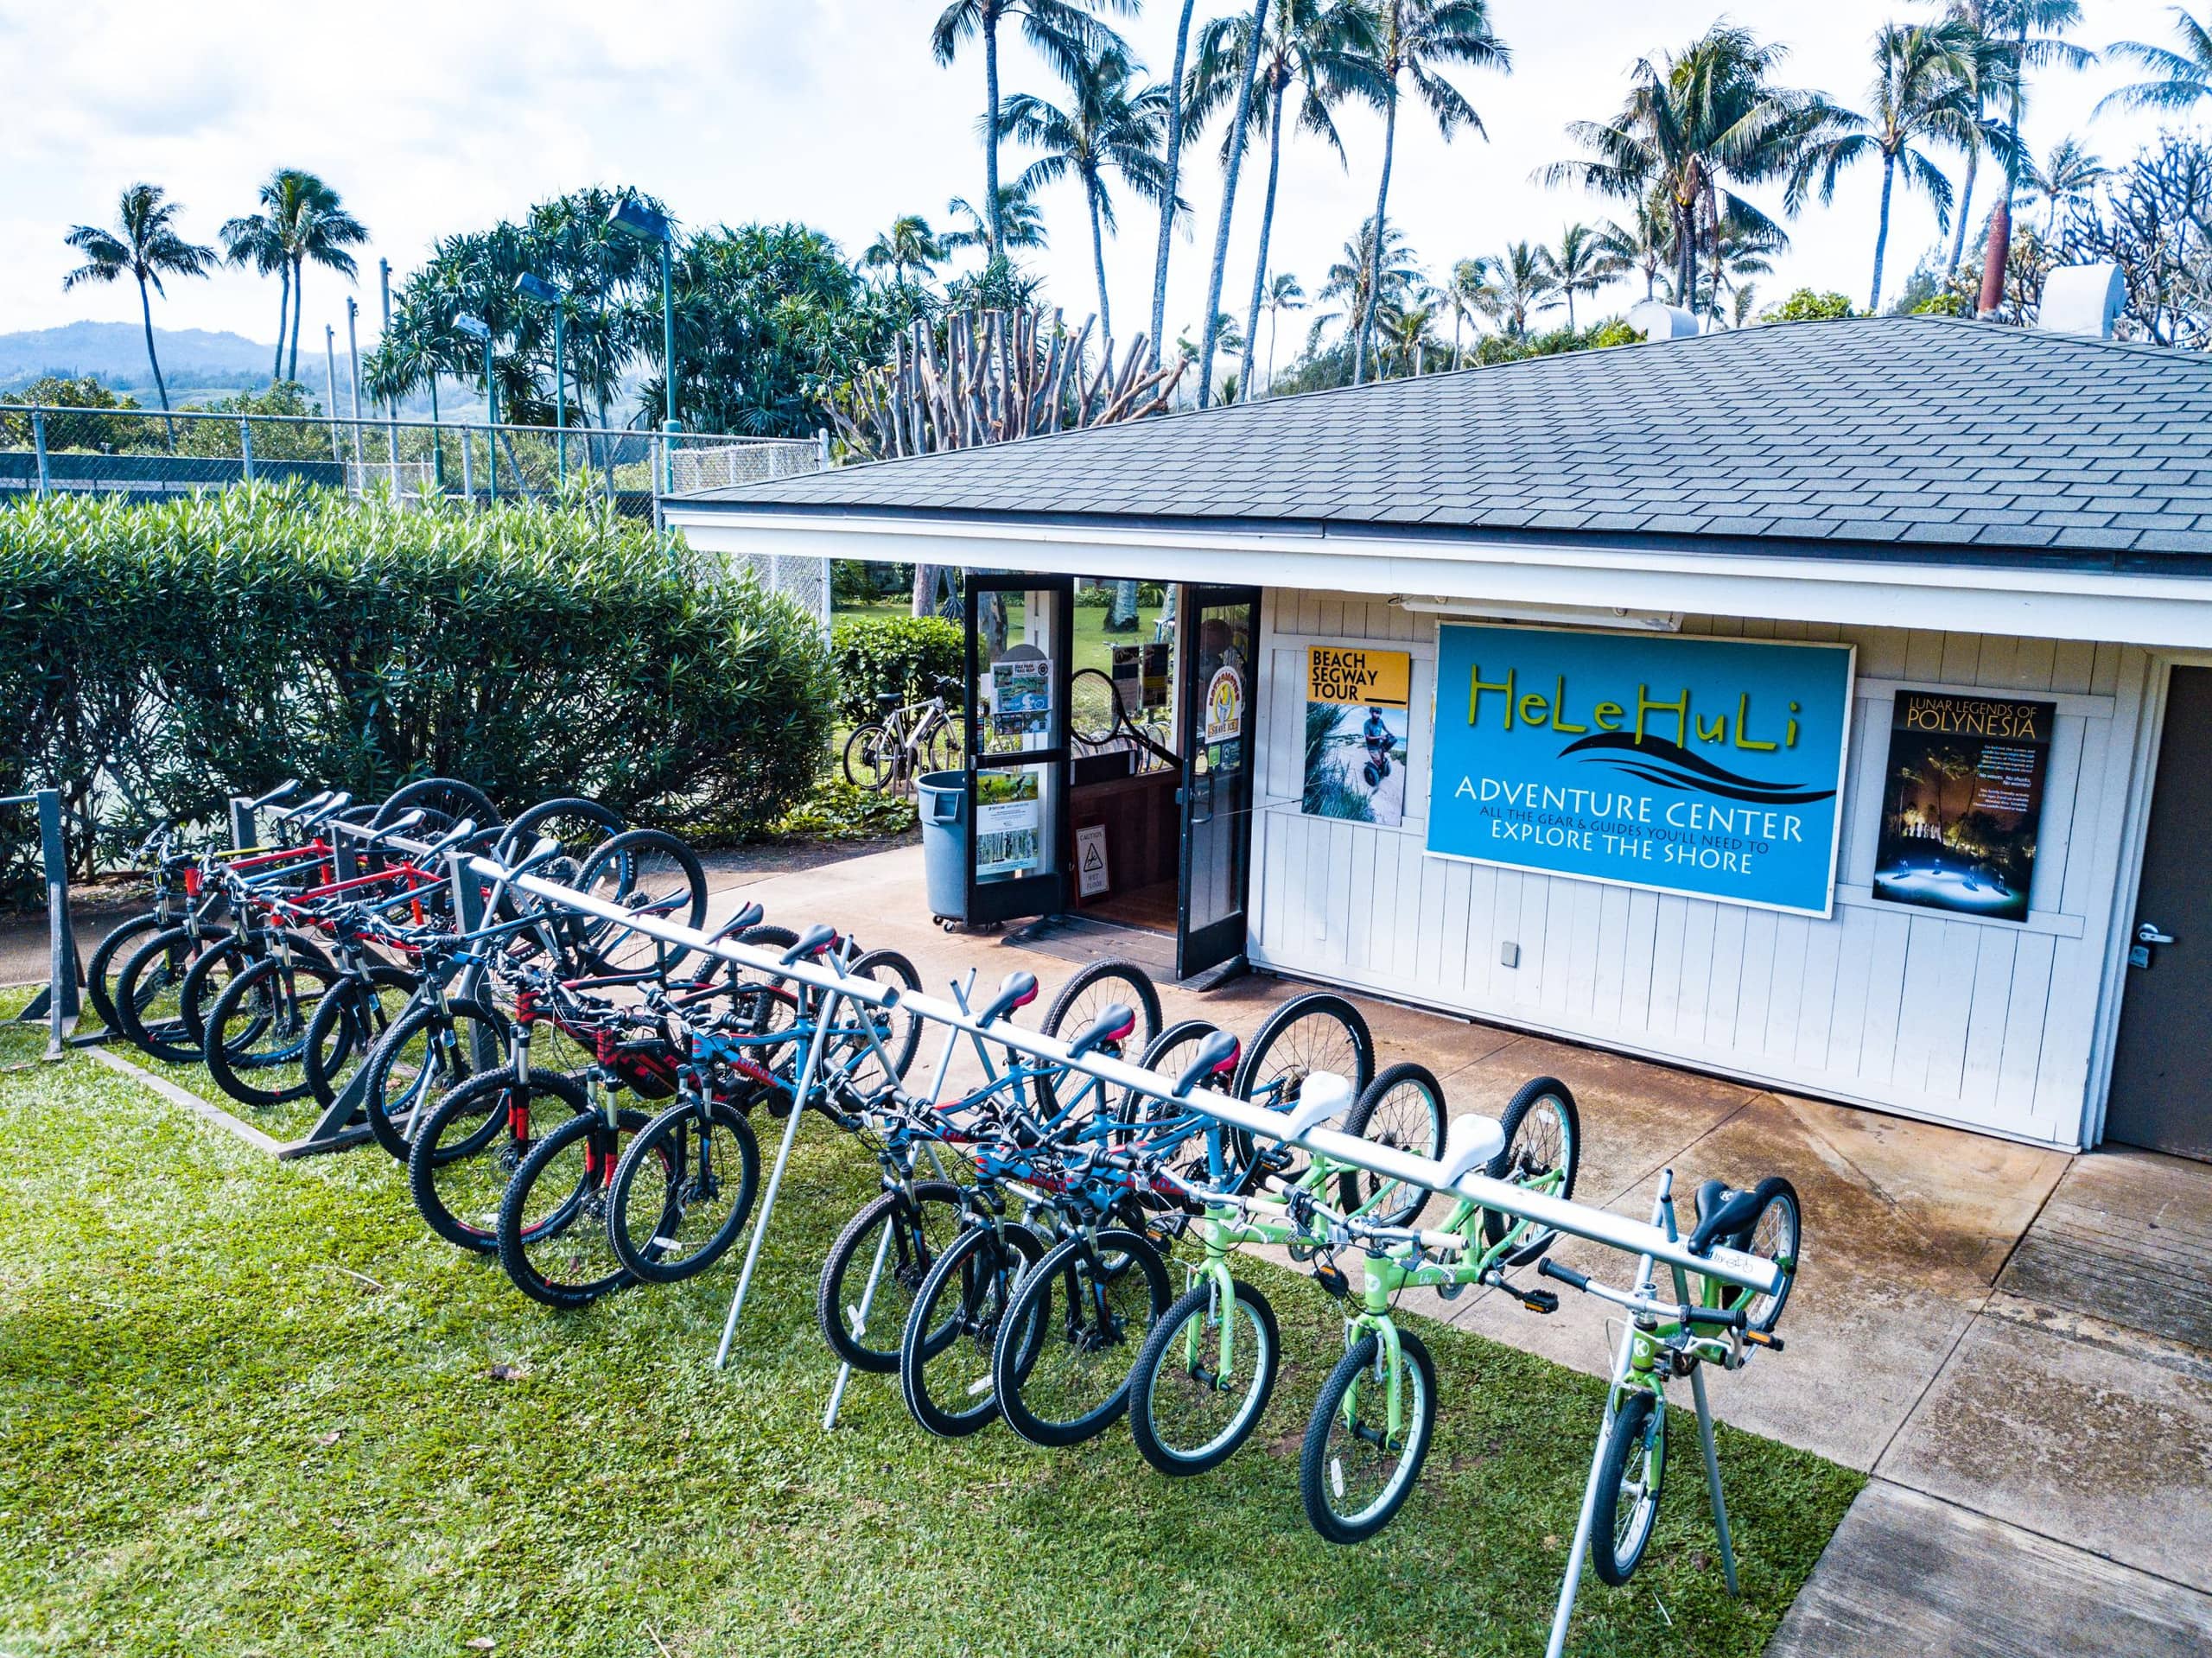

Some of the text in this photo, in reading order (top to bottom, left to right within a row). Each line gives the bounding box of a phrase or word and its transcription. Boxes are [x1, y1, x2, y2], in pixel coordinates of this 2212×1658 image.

[1313, 651, 1365, 669] BEACH
[1313, 667, 1378, 685] SEGWAY
[1313, 683, 1358, 701] TOUR
[1469, 664, 1801, 750] HeLeHuLi
[1910, 697, 2038, 719] LUNAR LEGENDS OF
[1907, 708, 2036, 739] POLYNESIA
[1454, 775, 1802, 842] ADVENTURE CENTER
[1080, 832, 1103, 842] CAUTION
[1479, 806, 1769, 854] ALL THE GEAR & GUIDES YOU'LL NEED TO
[1491, 819, 1752, 874] EXPLORE THE SHORE
[737, 1057, 775, 1081] GIANT
